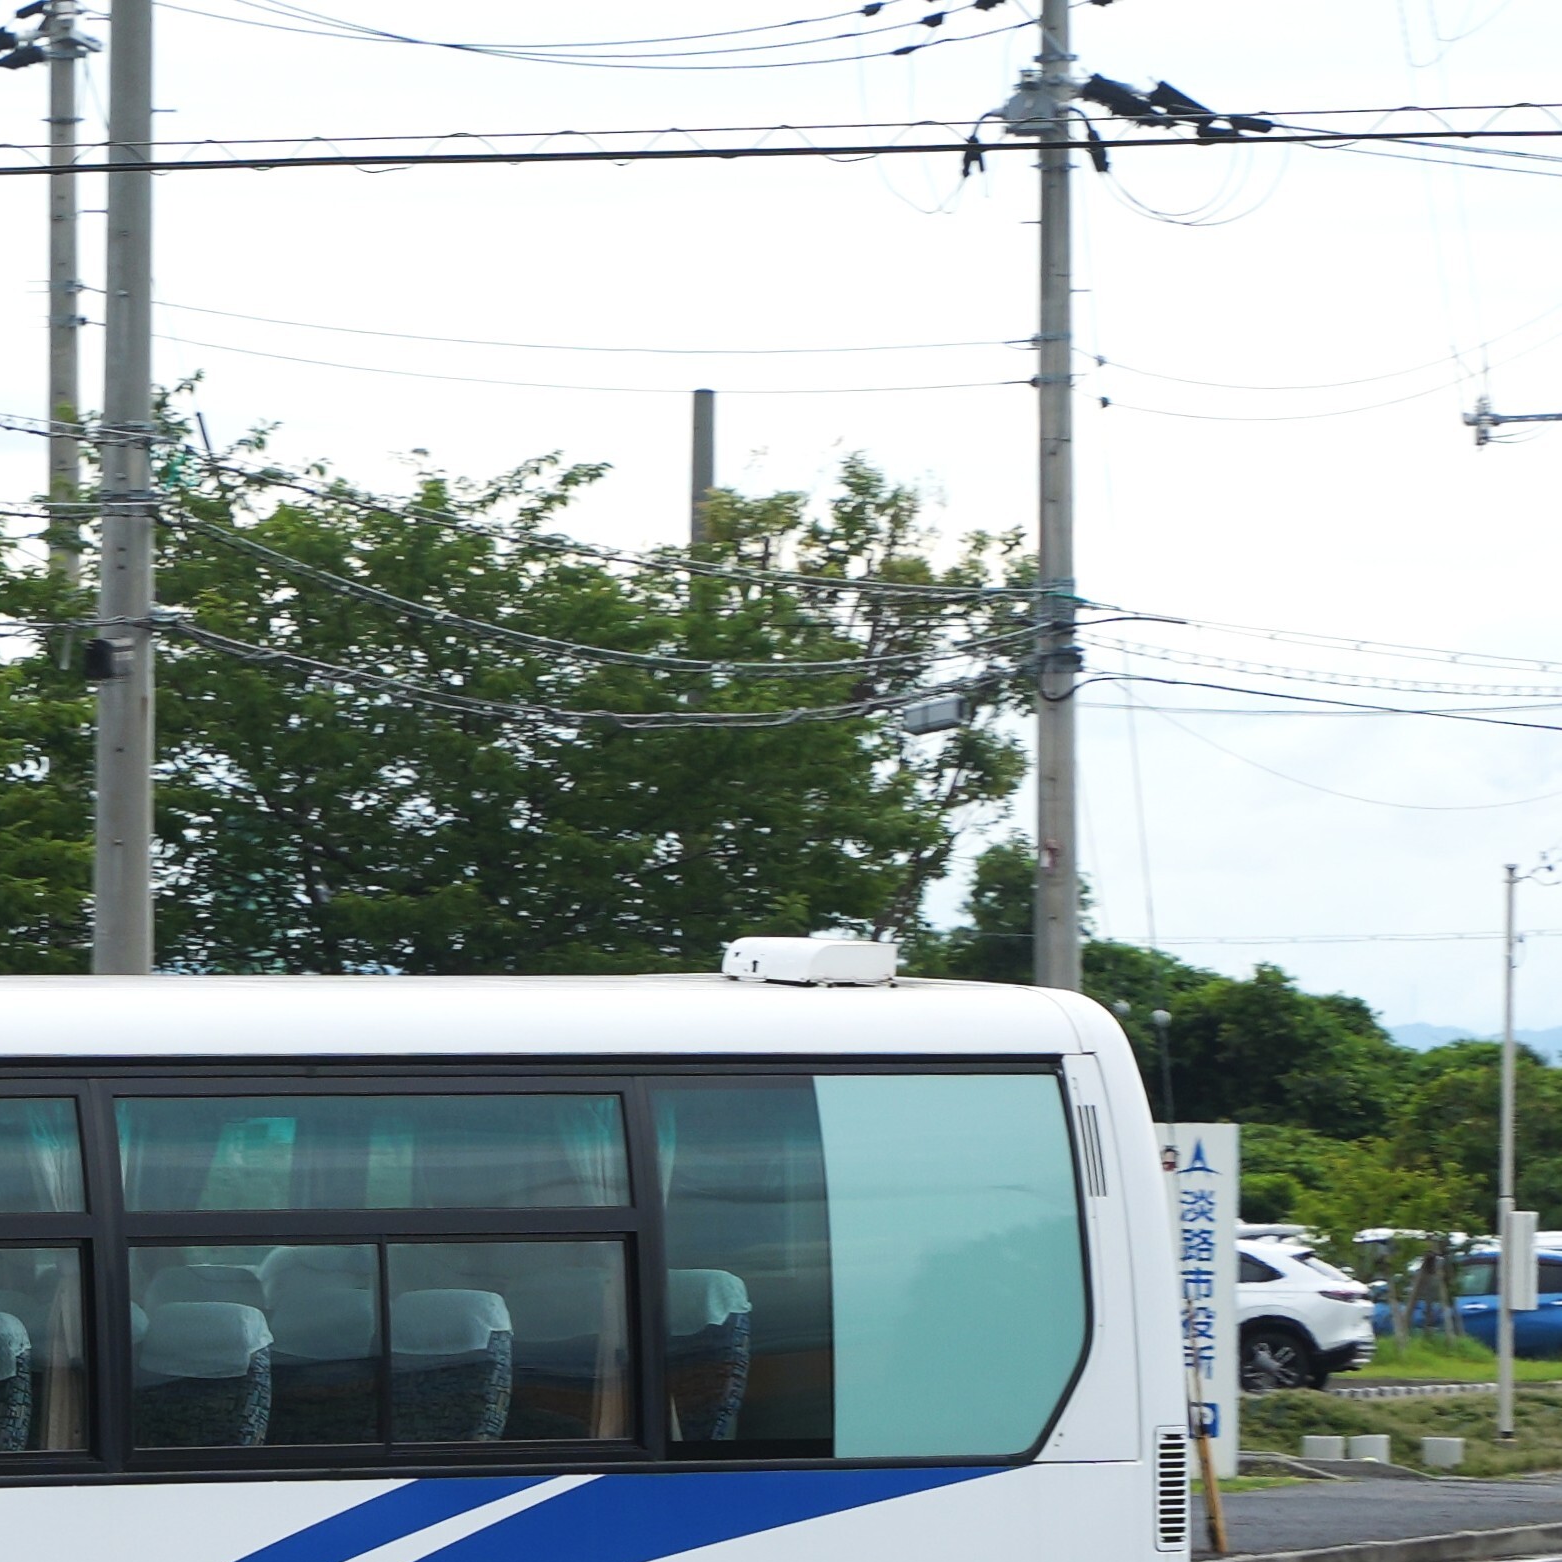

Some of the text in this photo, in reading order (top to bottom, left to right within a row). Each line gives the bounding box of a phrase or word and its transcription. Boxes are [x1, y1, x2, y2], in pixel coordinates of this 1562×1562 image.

[1180, 1190, 1215, 1380] 淡路市役所
